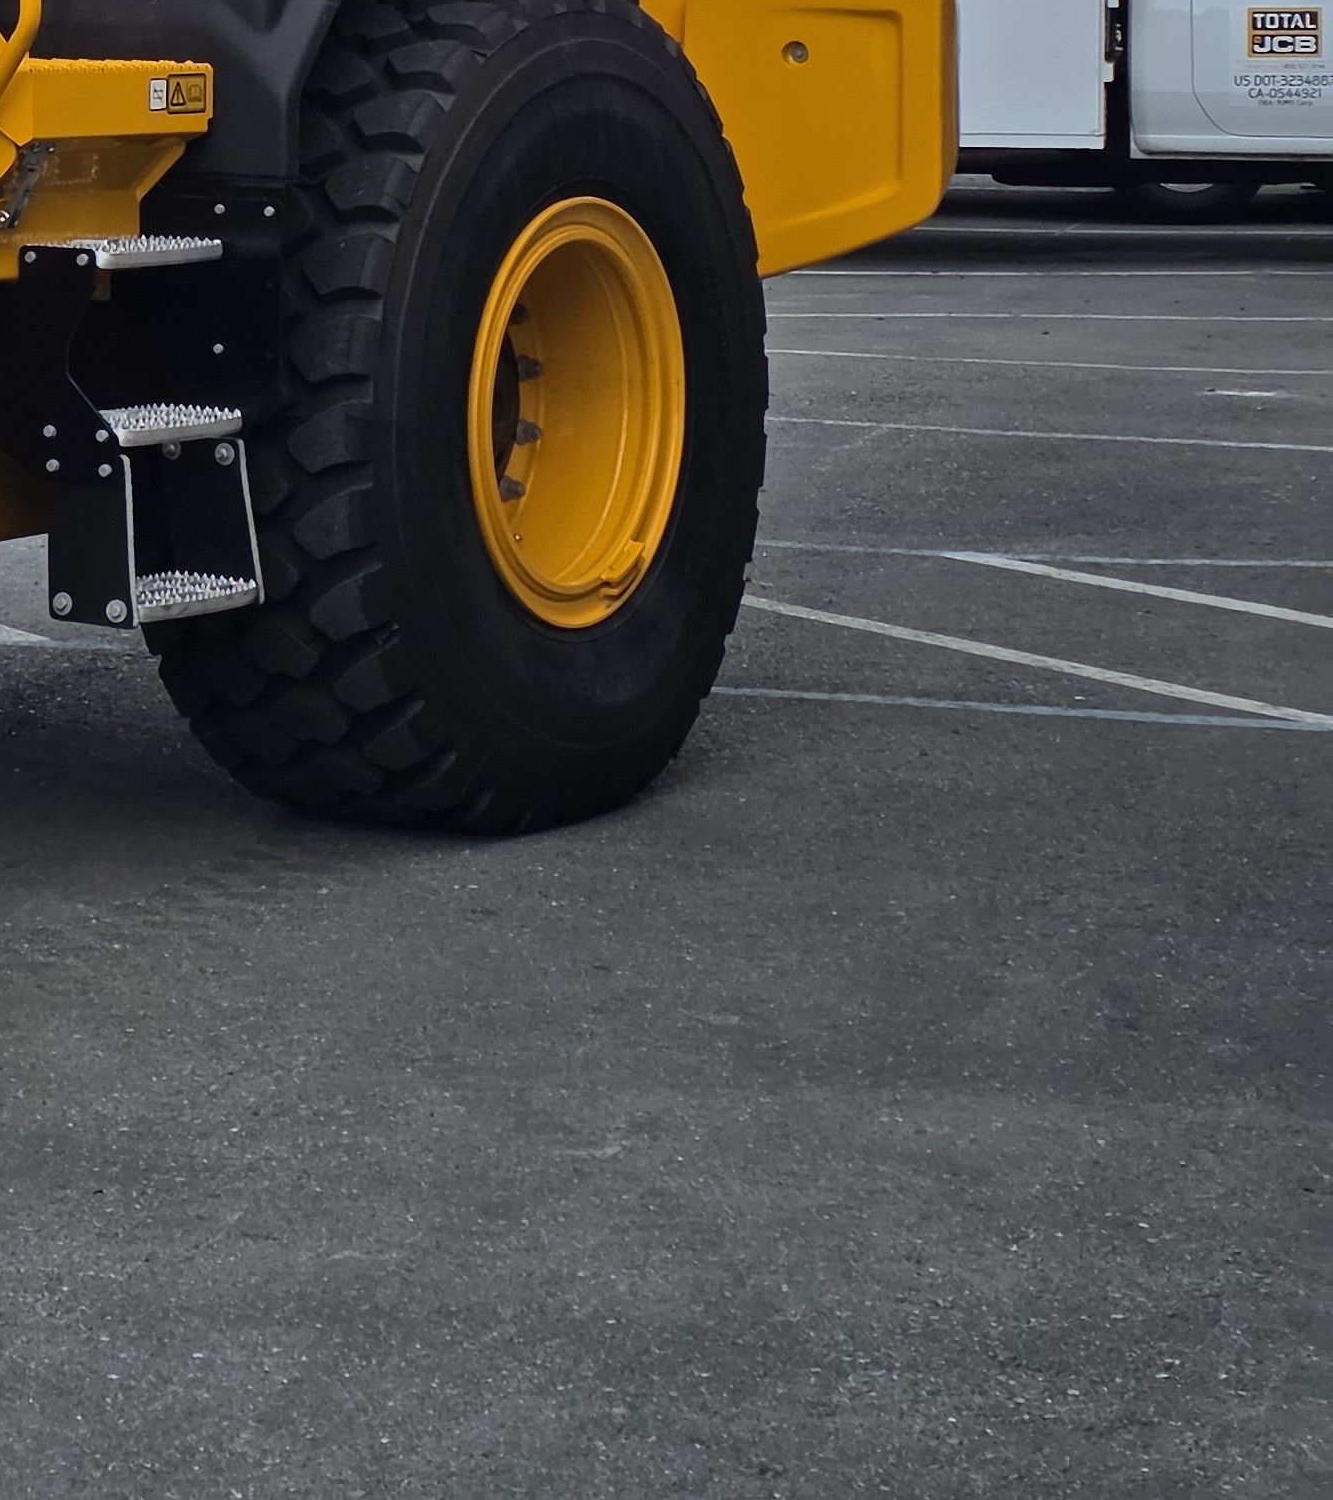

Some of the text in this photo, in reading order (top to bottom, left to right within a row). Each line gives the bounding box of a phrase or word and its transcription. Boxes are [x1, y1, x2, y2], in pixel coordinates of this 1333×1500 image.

[1253, 13, 1317, 29] TOTAL
[1253, 36, 1317, 53] JCB
[1234, 74, 1251, 87] US
